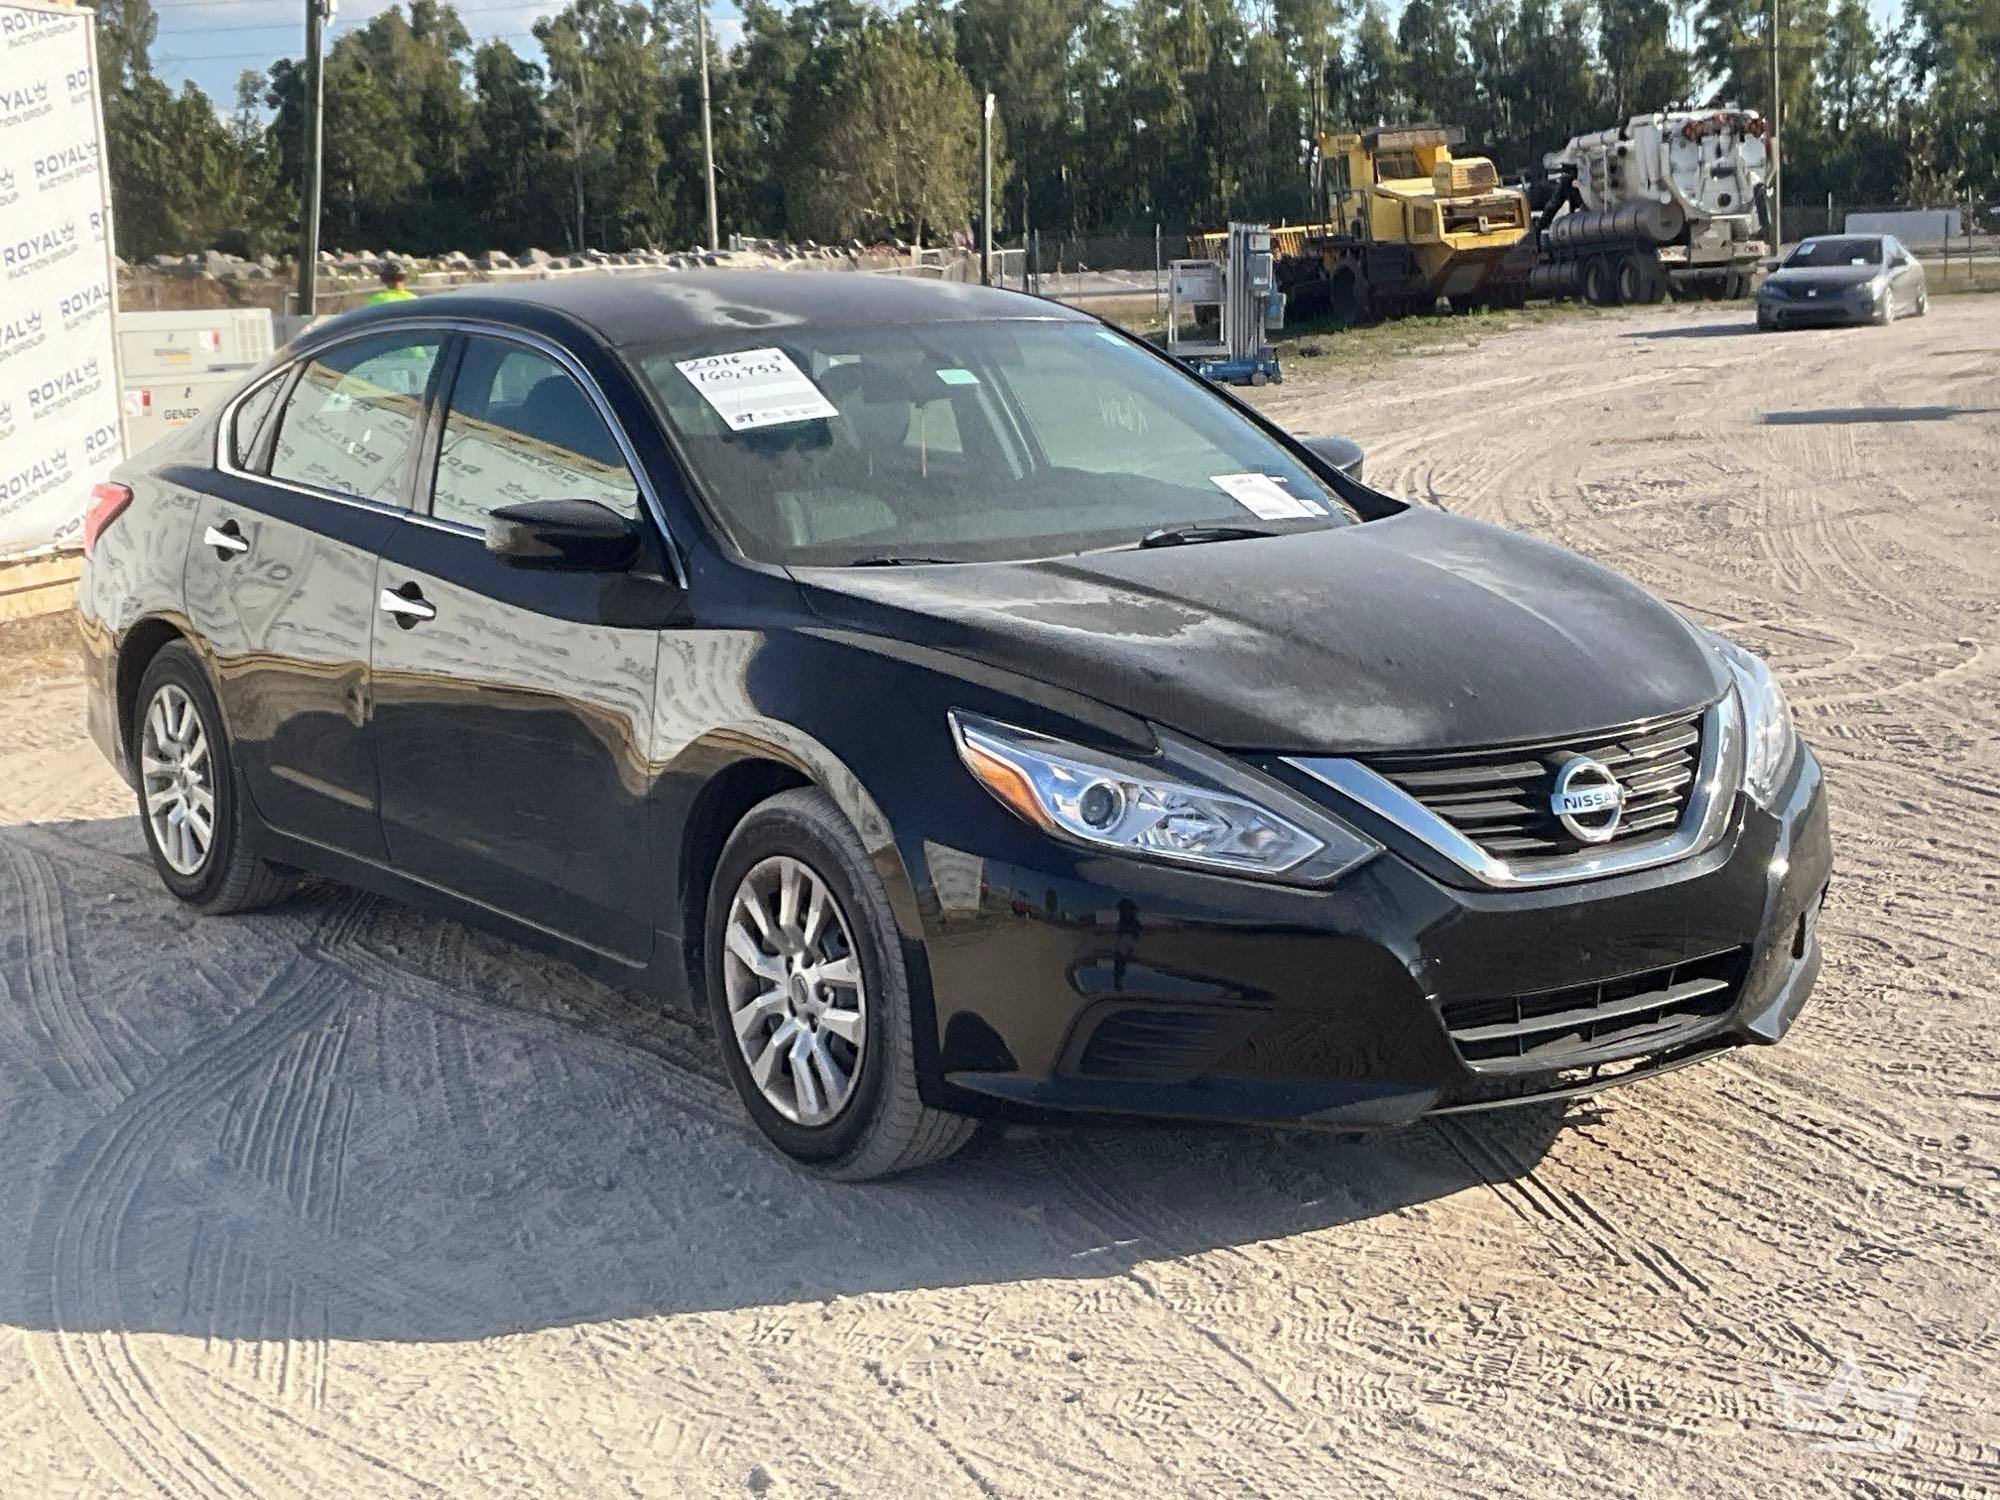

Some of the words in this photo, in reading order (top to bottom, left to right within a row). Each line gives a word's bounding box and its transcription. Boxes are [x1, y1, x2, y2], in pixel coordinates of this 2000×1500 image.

[66, 66, 92, 91] RO
[34, 145, 87, 178] ROYAL
[4, 230, 62, 267] ROYAL
[8, 258, 49, 280] AUCTION
[60, 282, 111, 318] ROYAL
[0, 321, 27, 345] AL
[685, 356, 741, 372] 2016
[28, 368, 85, 407] ROYAL
[33, 396, 72, 420] AUCTION
[72, 379, 102, 401] GROUP
[40, 471, 73, 494] GROUP
[1563, 790, 1619, 809] NISSAN
